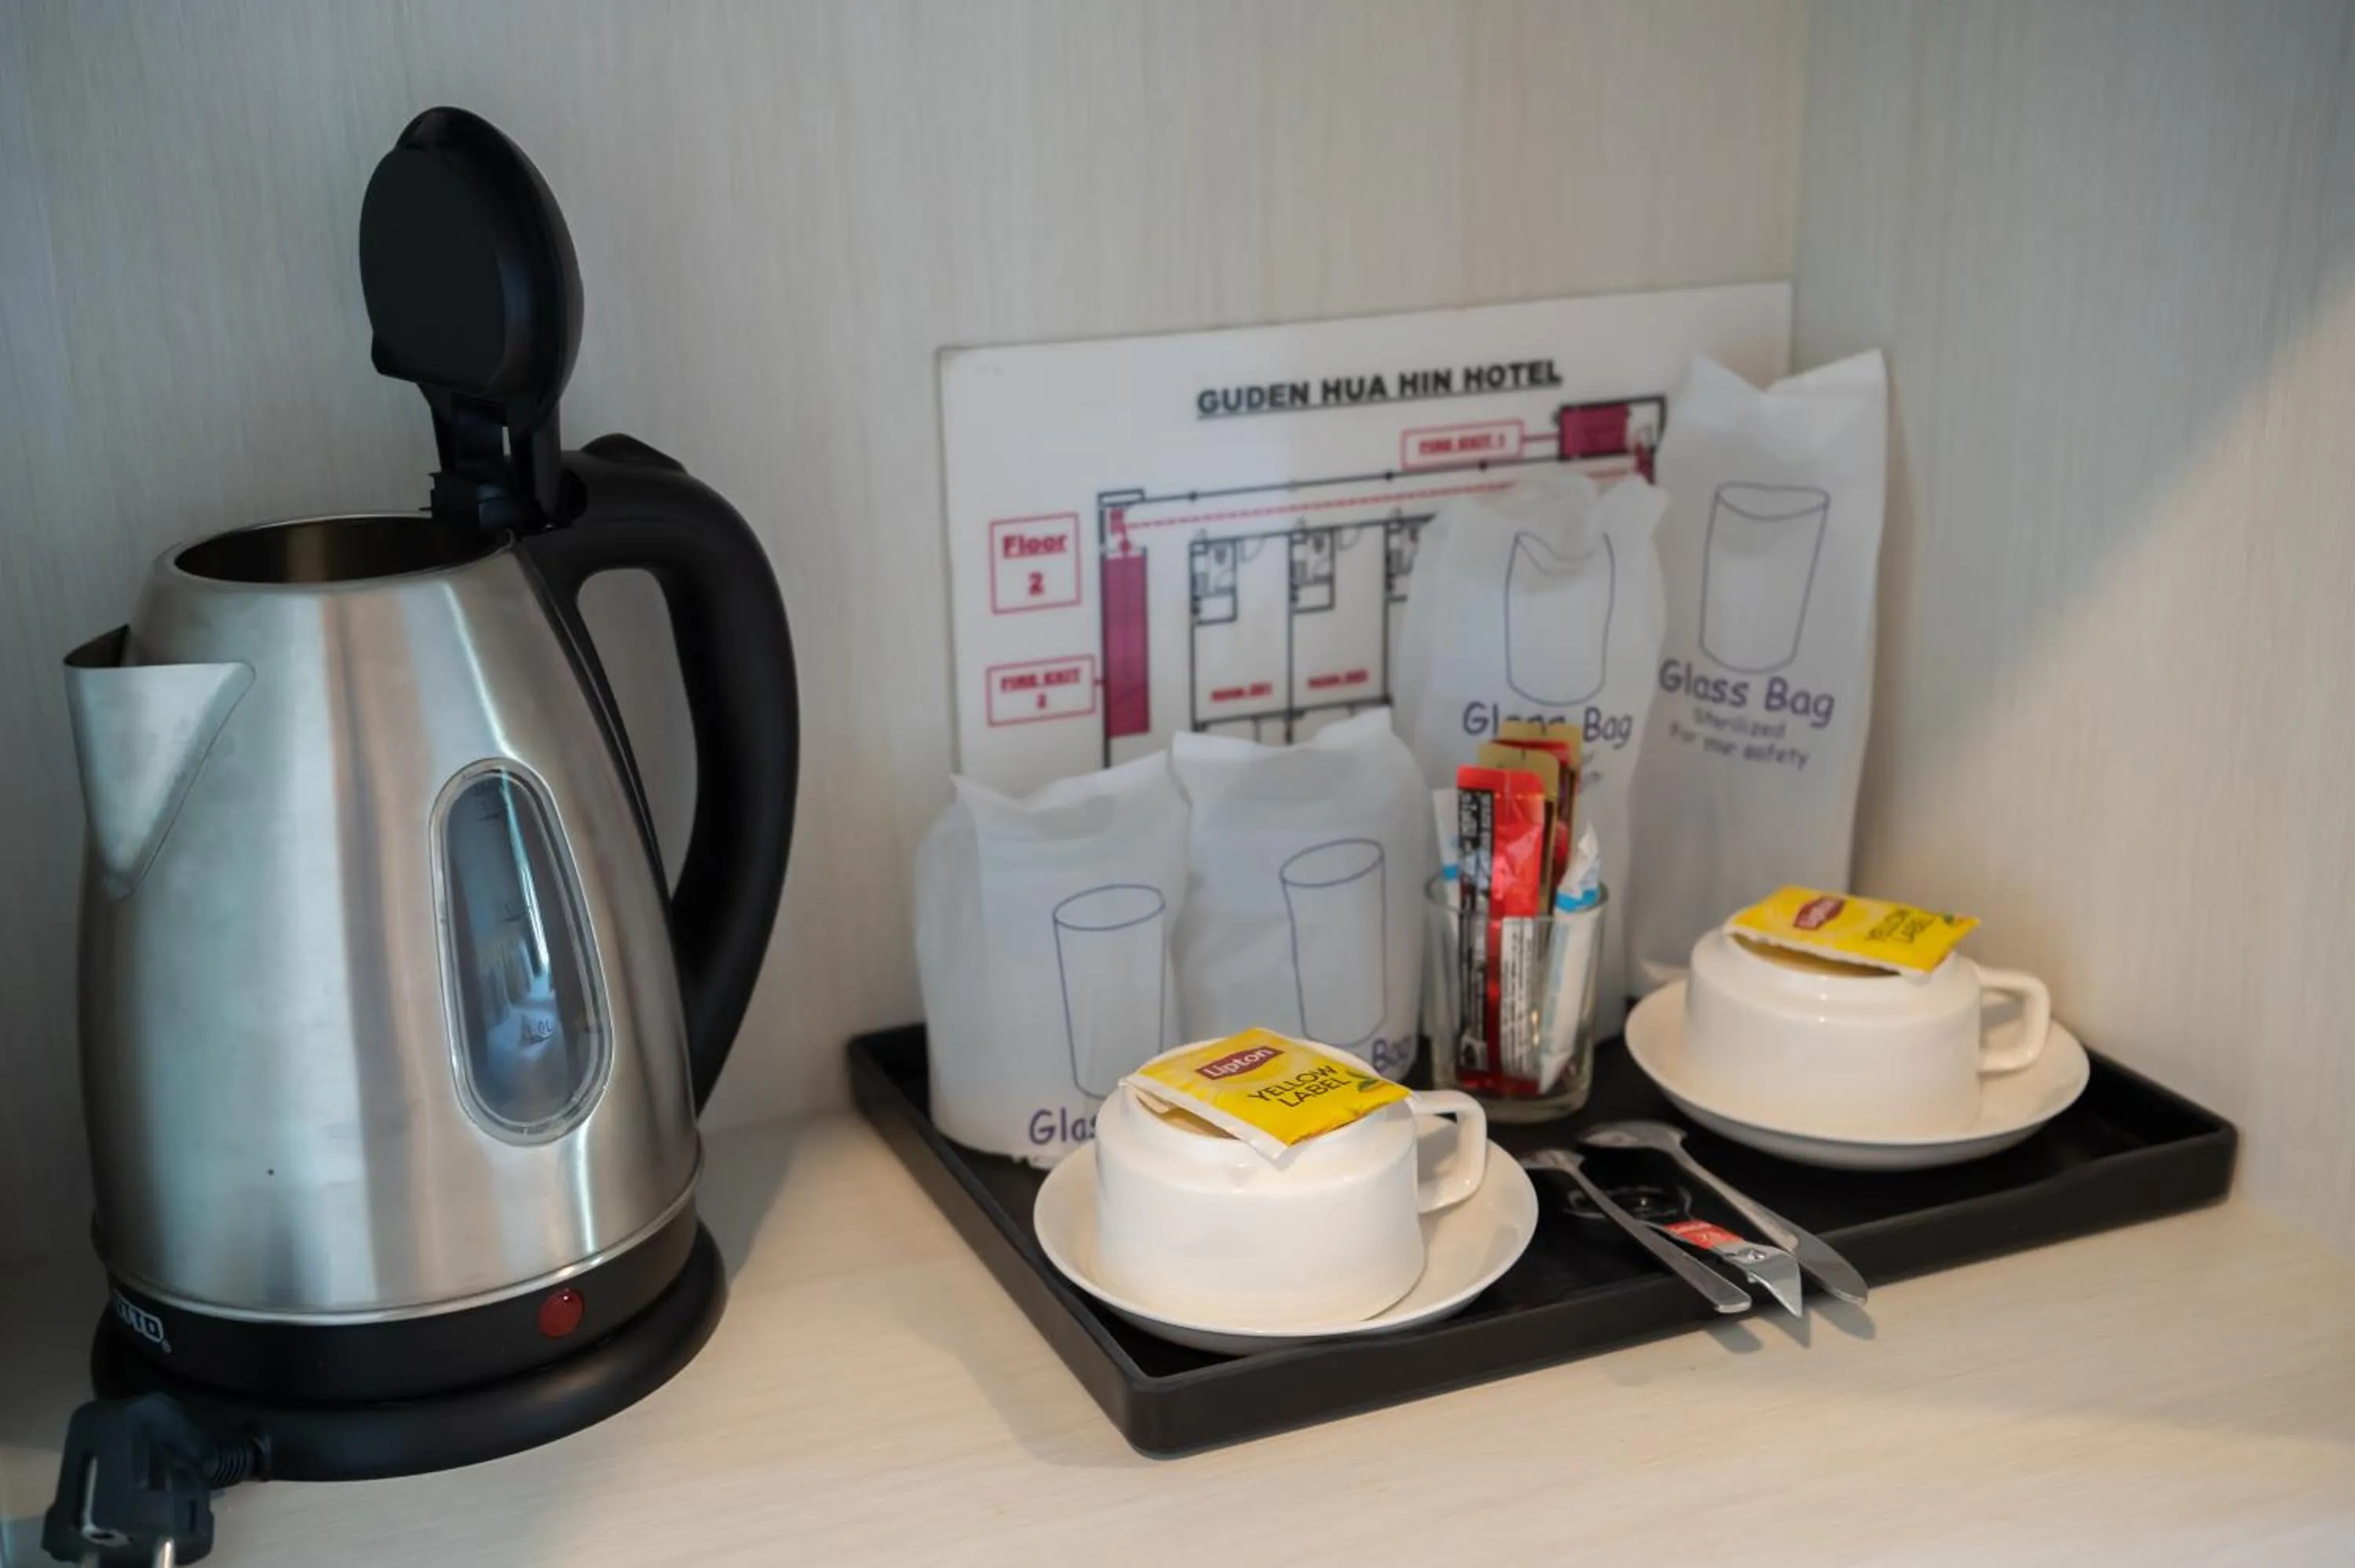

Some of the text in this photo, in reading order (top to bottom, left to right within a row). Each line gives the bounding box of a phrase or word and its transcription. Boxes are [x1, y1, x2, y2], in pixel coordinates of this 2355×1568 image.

[1197, 359, 1562, 414] GUDEN HUA HIN HOTEL
[1002, 534, 1068, 558] Floor
[1028, 571, 1045, 596] 2
[1659, 658, 1835, 729] Glass Bag
[1583, 707, 1633, 749] Bag
[1203, 1047, 1275, 1078] Lipton
[1247, 1064, 1338, 1102] YELLOW
[1279, 1077, 1352, 1107] LABEL
